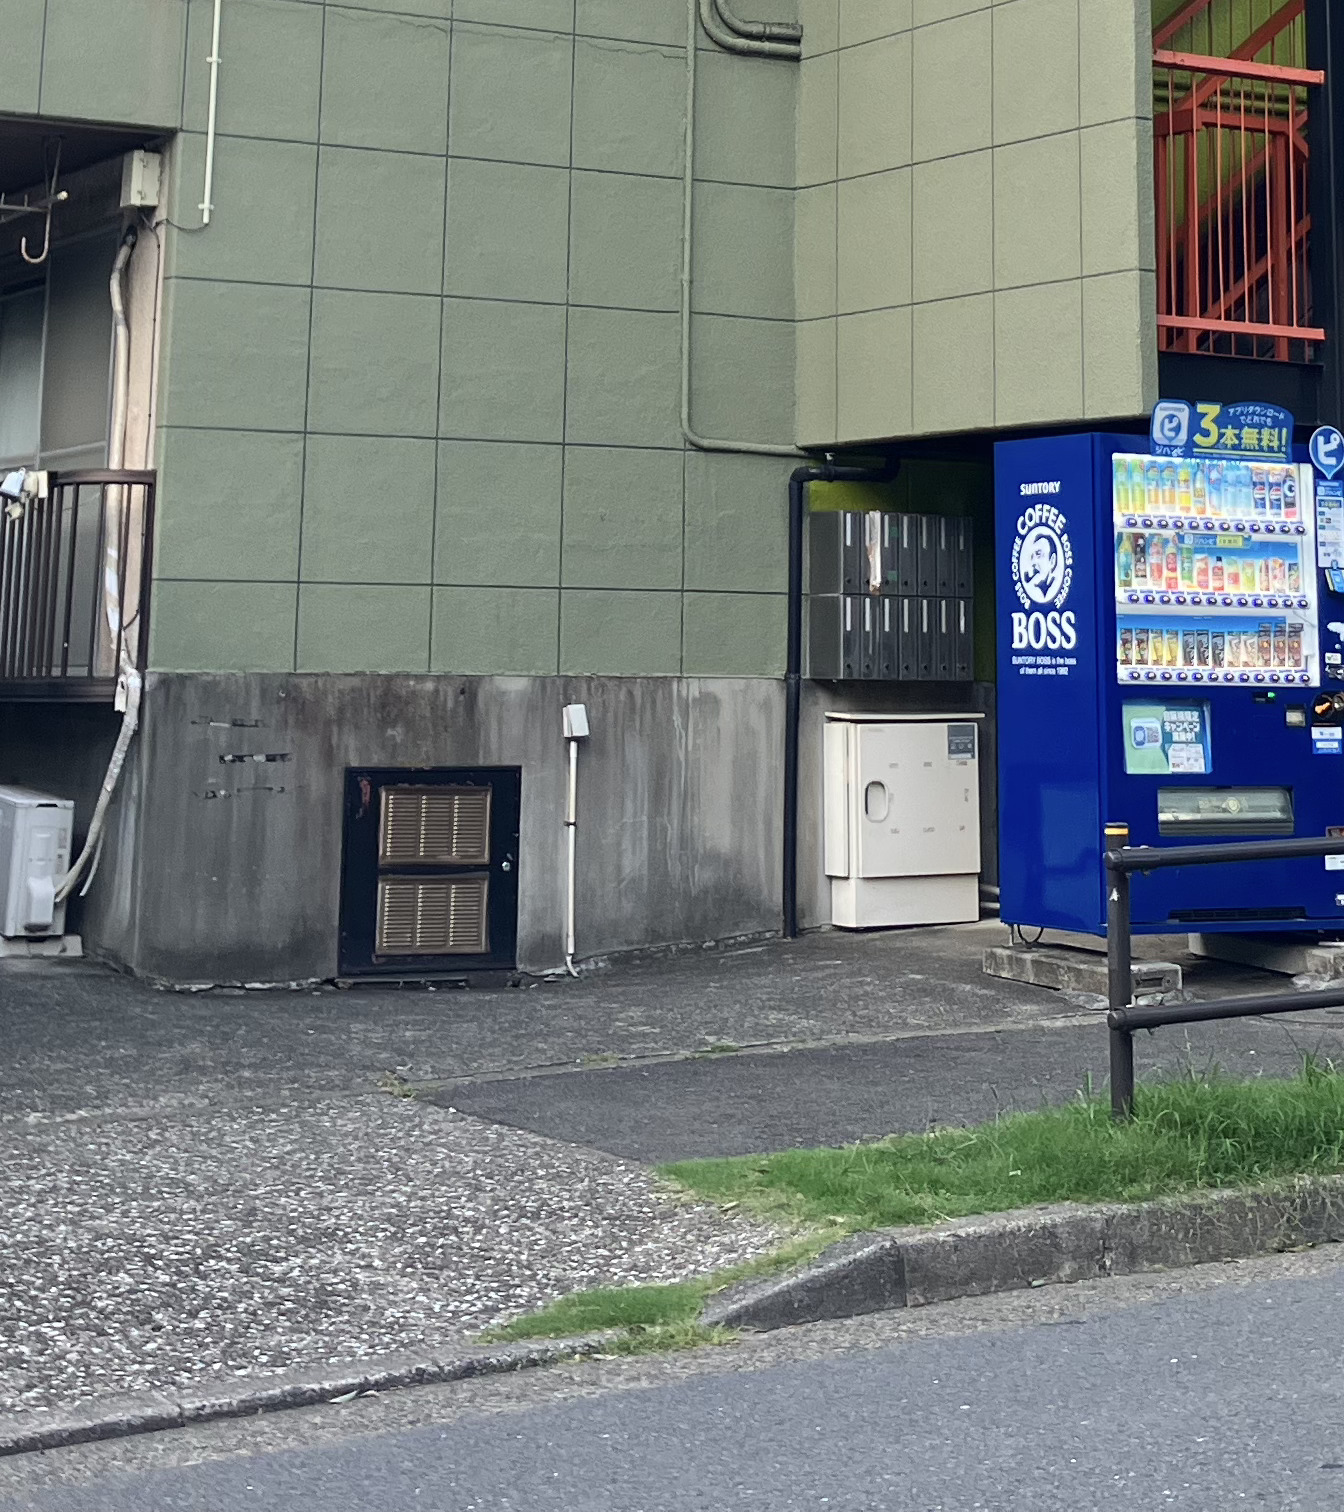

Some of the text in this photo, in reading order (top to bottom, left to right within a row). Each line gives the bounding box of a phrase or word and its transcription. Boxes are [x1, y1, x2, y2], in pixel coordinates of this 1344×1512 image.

[1317, 433, 1341, 465] ピ
[1019, 481, 1061, 496] SUNTORY
[1017, 503, 1066, 536] COFFEE
[1011, 610, 1077, 650] BOSS
